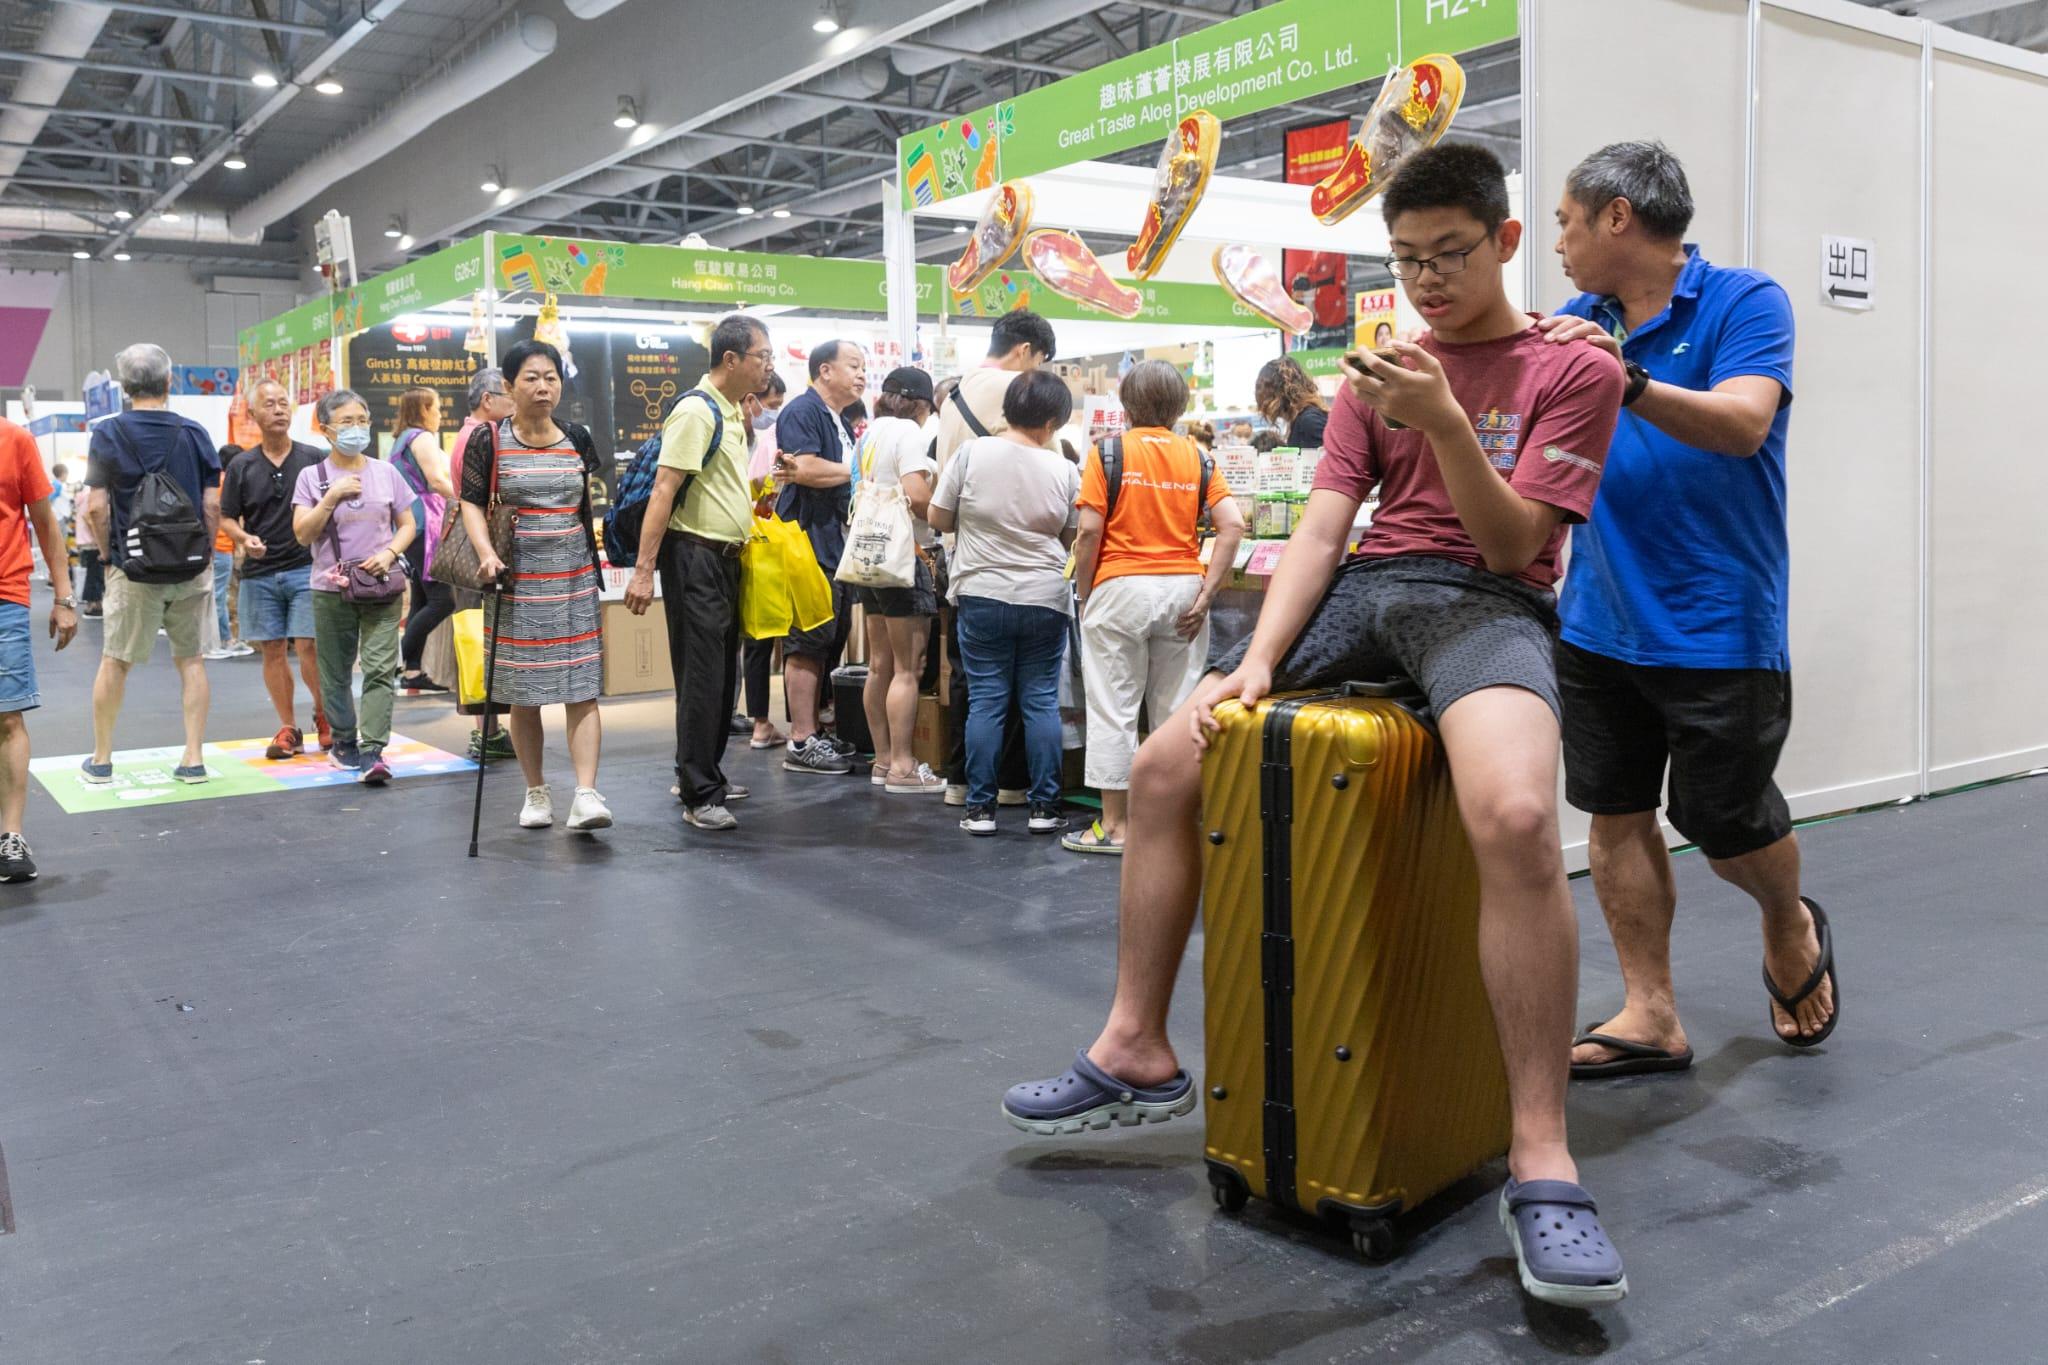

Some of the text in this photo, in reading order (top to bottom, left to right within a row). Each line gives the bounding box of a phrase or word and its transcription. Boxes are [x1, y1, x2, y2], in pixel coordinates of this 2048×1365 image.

[1098, 23, 1299, 112] 趣味蘆薈發展有限公司
[1058, 43, 1359, 149] Great Taste Aloe Development Co. Ltd.
[454, 257, 480, 283] G26-27
[1829, 242, 1868, 281] 出口
[671, 277, 797, 296] Hang Chun Trading Co.
[366, 358, 402, 369] Gins15
[413, 374, 466, 387] Compound
